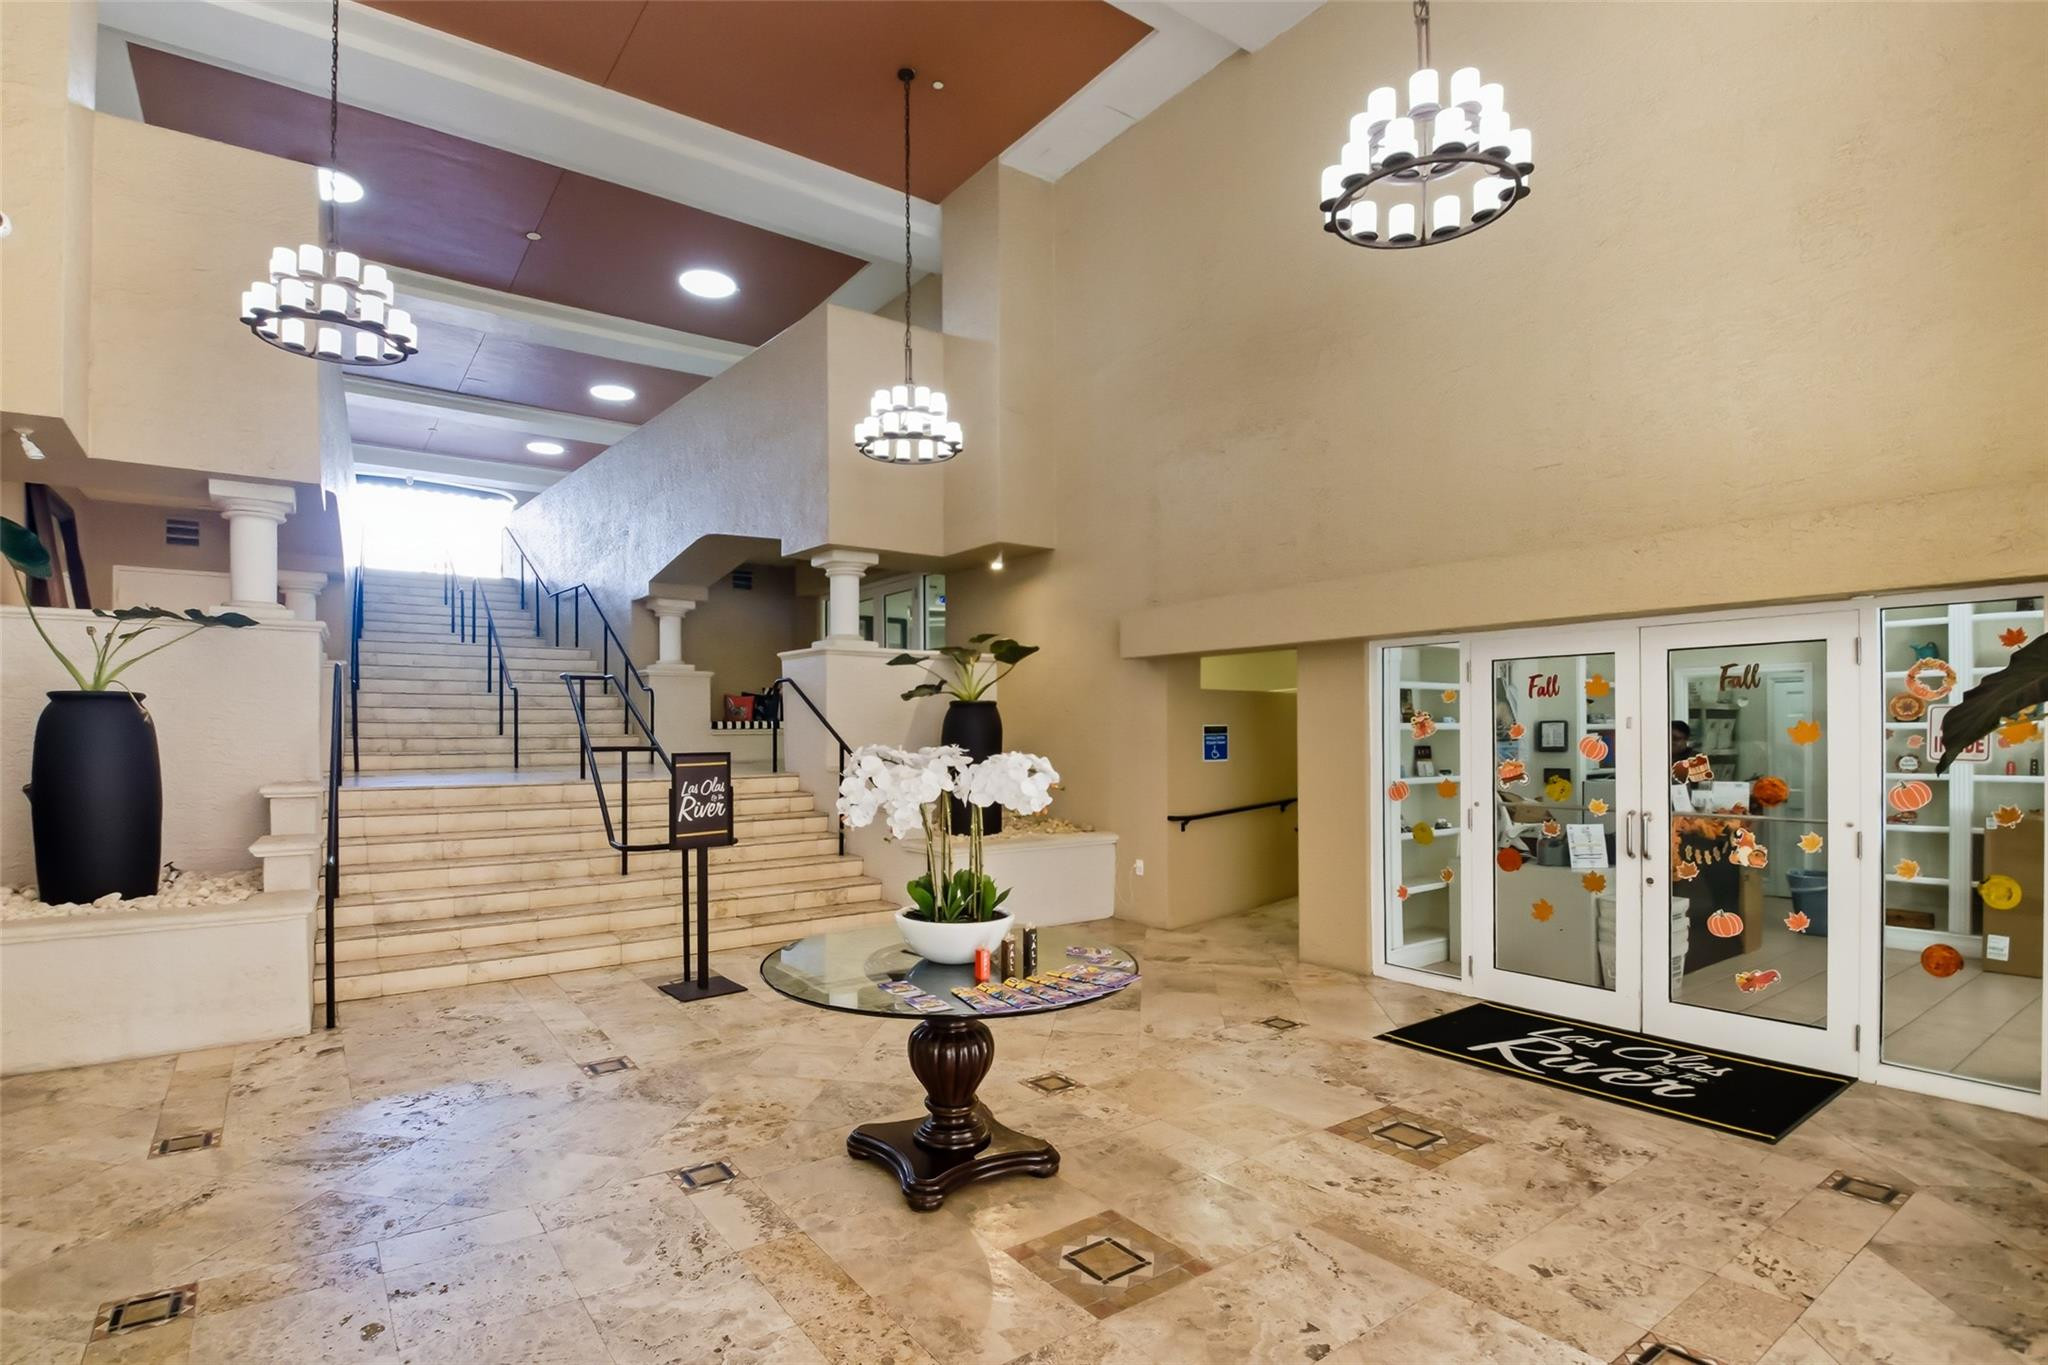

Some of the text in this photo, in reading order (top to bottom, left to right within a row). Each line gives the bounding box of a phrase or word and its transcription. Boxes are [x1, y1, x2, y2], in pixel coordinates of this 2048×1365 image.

[1528, 673, 1560, 699] Fall
[1719, 663, 1761, 692] Fall
[681, 776, 725, 797] Las Olas
[678, 795, 726, 822] River
[1527, 1027, 1733, 1077] Las Olas
[1467, 1036, 1696, 1097] River
